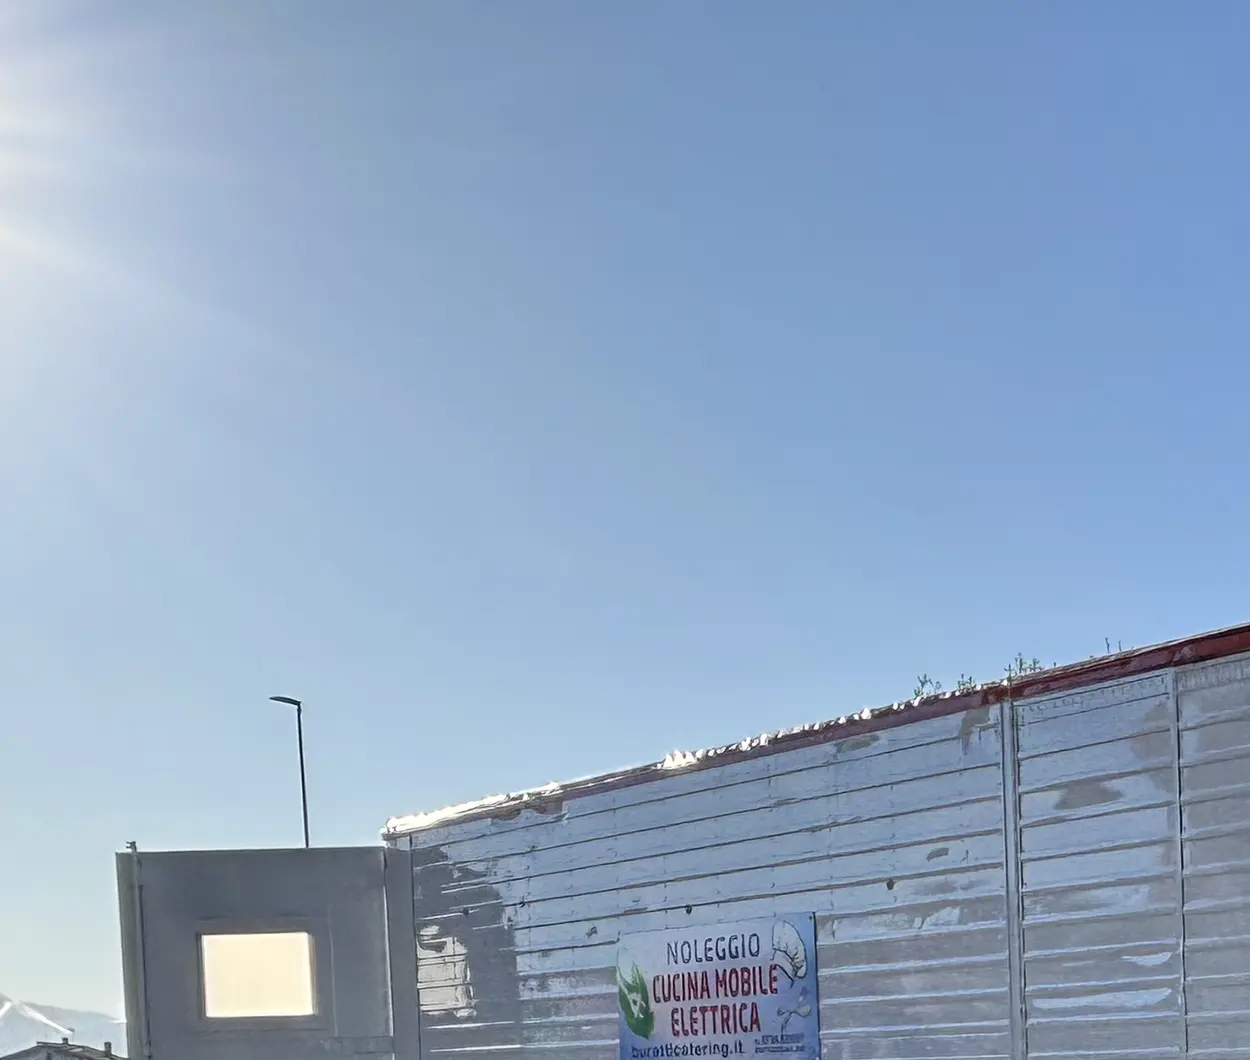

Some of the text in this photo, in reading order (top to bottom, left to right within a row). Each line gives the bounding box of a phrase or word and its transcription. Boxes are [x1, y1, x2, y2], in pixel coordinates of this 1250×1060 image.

[666, 933, 760, 966] NOLEGGIO
[652, 964, 778, 1004] CUCINA MOBILE
[671, 1002, 761, 1037] ELETTRICA
